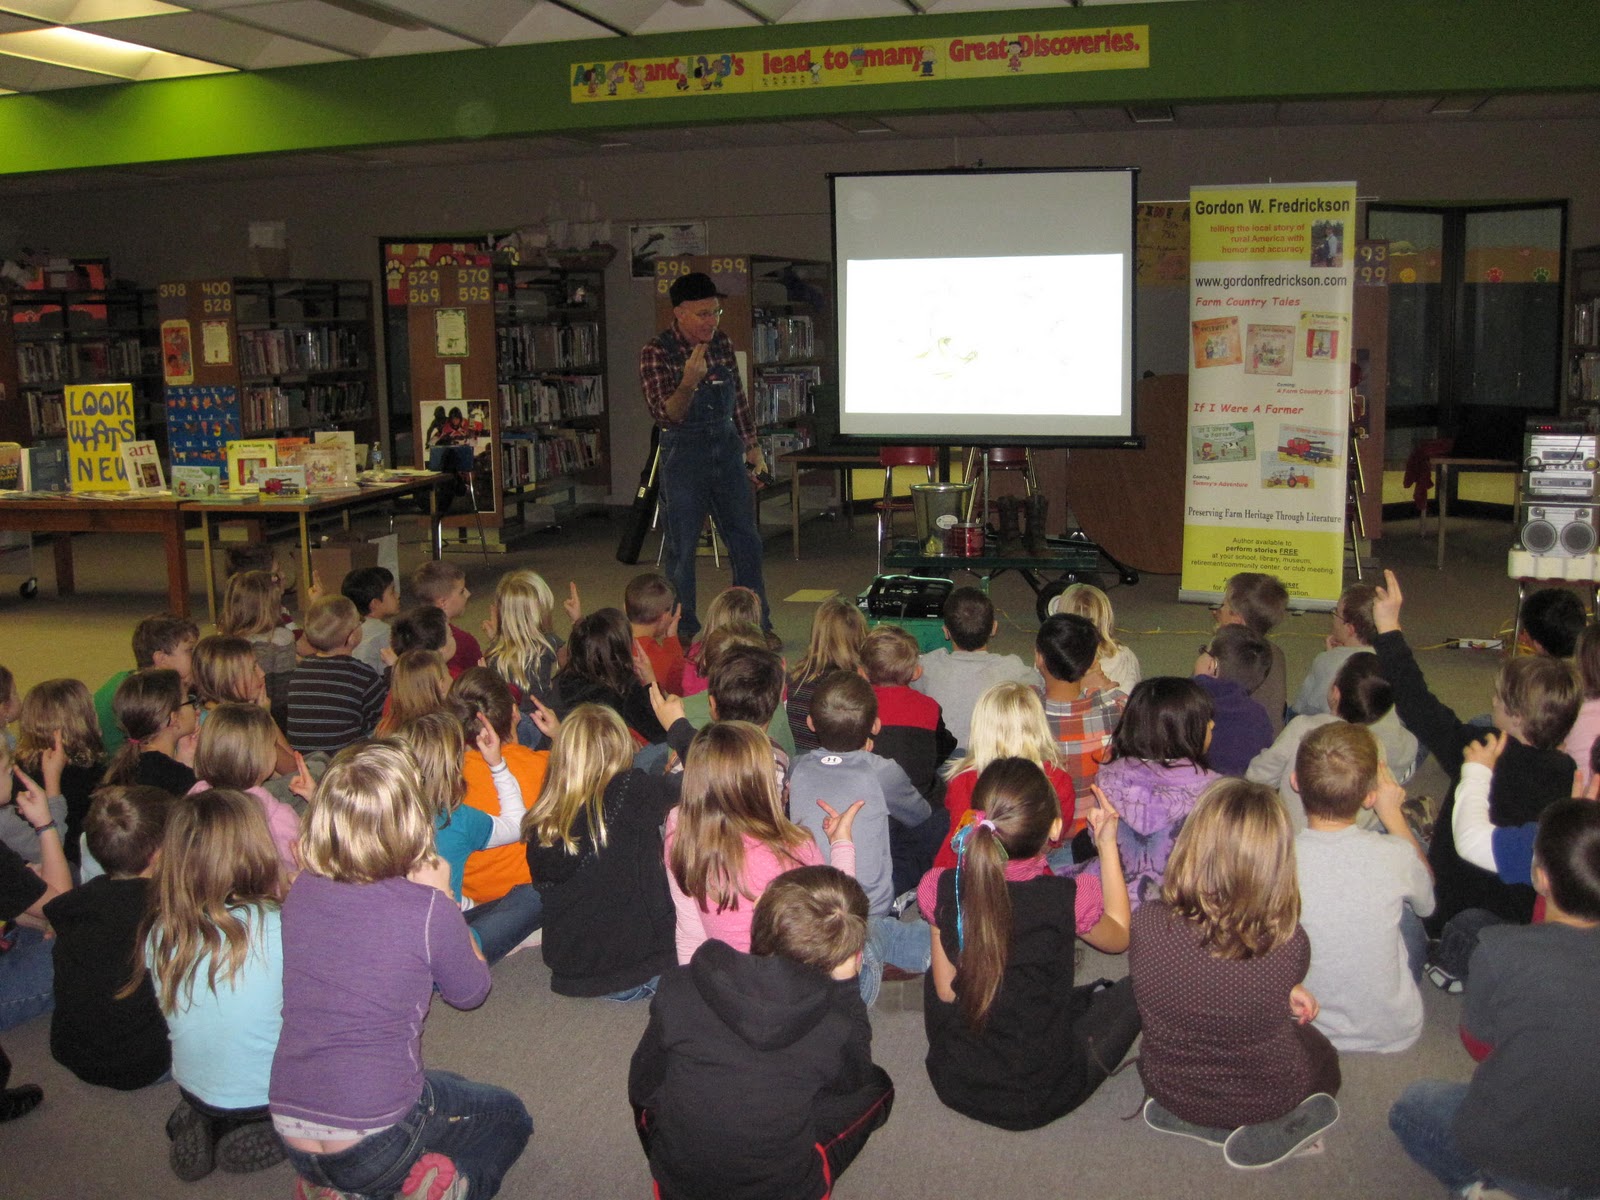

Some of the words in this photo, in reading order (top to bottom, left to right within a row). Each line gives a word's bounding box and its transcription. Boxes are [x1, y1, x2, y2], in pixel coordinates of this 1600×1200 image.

[763, 50, 811, 74] lead
[823, 48, 849, 70] to
[863, 46, 923, 72] many
[950, 37, 1008, 62] Great
[1019, 30, 1140, 58] Discoveries.
[1195, 200, 1244, 215] Gordon
[1249, 199, 1264, 214] W.
[1269, 197, 1350, 213] Fredrickson
[1210, 225, 1235, 234] telling
[1252, 224, 1271, 232] local
[1273, 224, 1294, 233] story
[1296, 223, 1305, 231] of
[1287, 234, 1305, 242] with
[1267, 245, 1305, 254] accuracy
[1360, 246, 1386, 262] 93
[657, 261, 690, 275] 596
[1360, 267, 1386, 282] 99
[408, 270, 439, 285] 529
[458, 269, 490, 283] 570
[1195, 274, 1347, 289] www.gordonfredrickson.com
[160, 283, 186, 297] 398
[201, 281, 231, 295] 400
[409, 288, 439, 303] 569
[459, 287, 490, 301] 595
[204, 299, 232, 312] 528
[1196, 297, 1221, 306] Farm
[1226, 297, 1267, 308] Country
[1272, 297, 1300, 306] Tales
[70, 390, 131, 416] LOOK
[1193, 403, 1204, 412] If
[1209, 403, 1216, 412] I
[1220, 403, 1248, 413] Were
[1253, 404, 1261, 412] A
[1265, 404, 1304, 415] Farmer
[129, 444, 154, 457] art
[1188, 507, 1223, 520] Preserving
[1225, 509, 1243, 518] Farm
[1244, 510, 1274, 522] Heritage
[1275, 511, 1304, 523] Through
[1306, 513, 1342, 523] Literature
[1232, 537, 1253, 545] Author
[1255, 538, 1284, 546] available
[1226, 546, 1253, 554] perform
[1279, 548, 1298, 556] FREE
[1259, 555, 1281, 563] library,
[1307, 566, 1335, 574] meeting.
